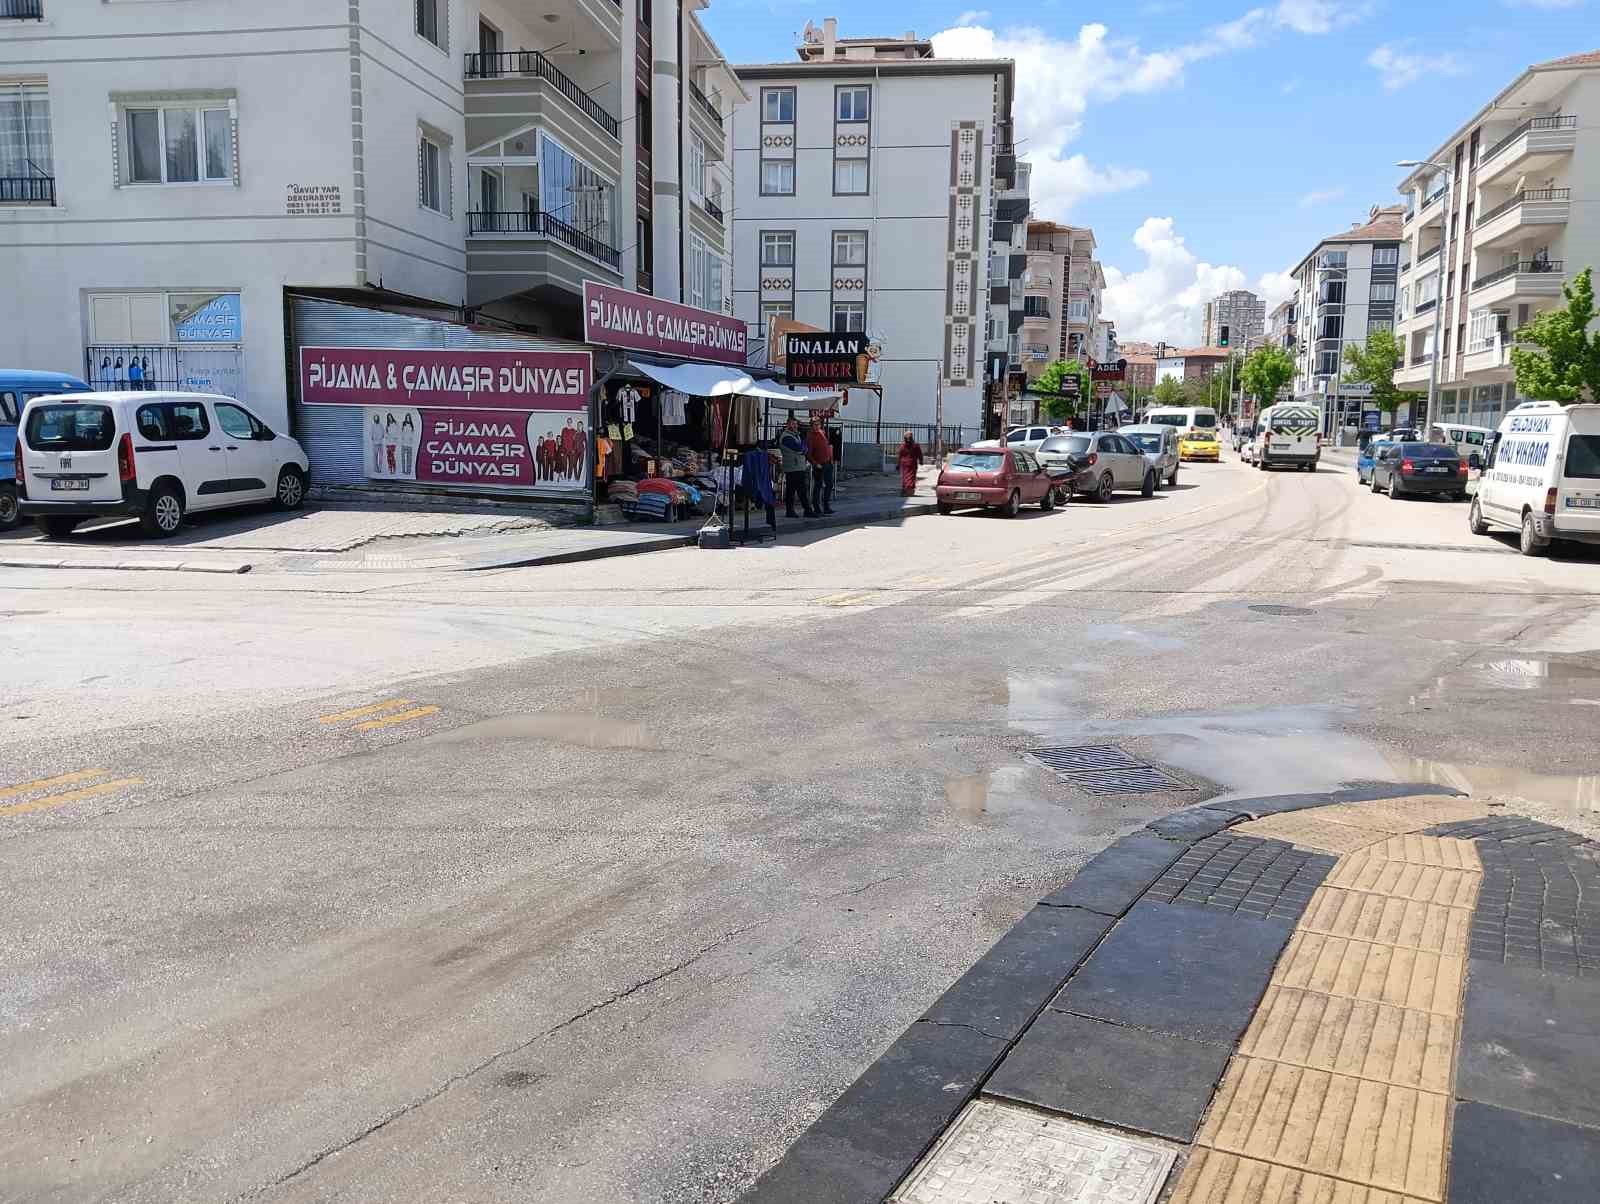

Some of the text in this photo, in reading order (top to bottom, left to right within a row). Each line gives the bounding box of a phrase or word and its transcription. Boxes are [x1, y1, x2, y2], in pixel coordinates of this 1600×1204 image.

[589, 293, 643, 335] PİJAMA
[646, 310, 654, 336] &
[656, 314, 707, 352] ÇAMAŞIR
[708, 320, 746, 353] DÜNYASI
[788, 338, 859, 354] ÜNALAN
[793, 359, 852, 378] DÖNER
[309, 356, 584, 401] PİJAMA & ÇAMAŞIR DÜNYASI
[434, 418, 516, 437] PİJAMA
[427, 441, 525, 460] ÇAMAŞIR
[431, 457, 520, 477] DÜNYASI
